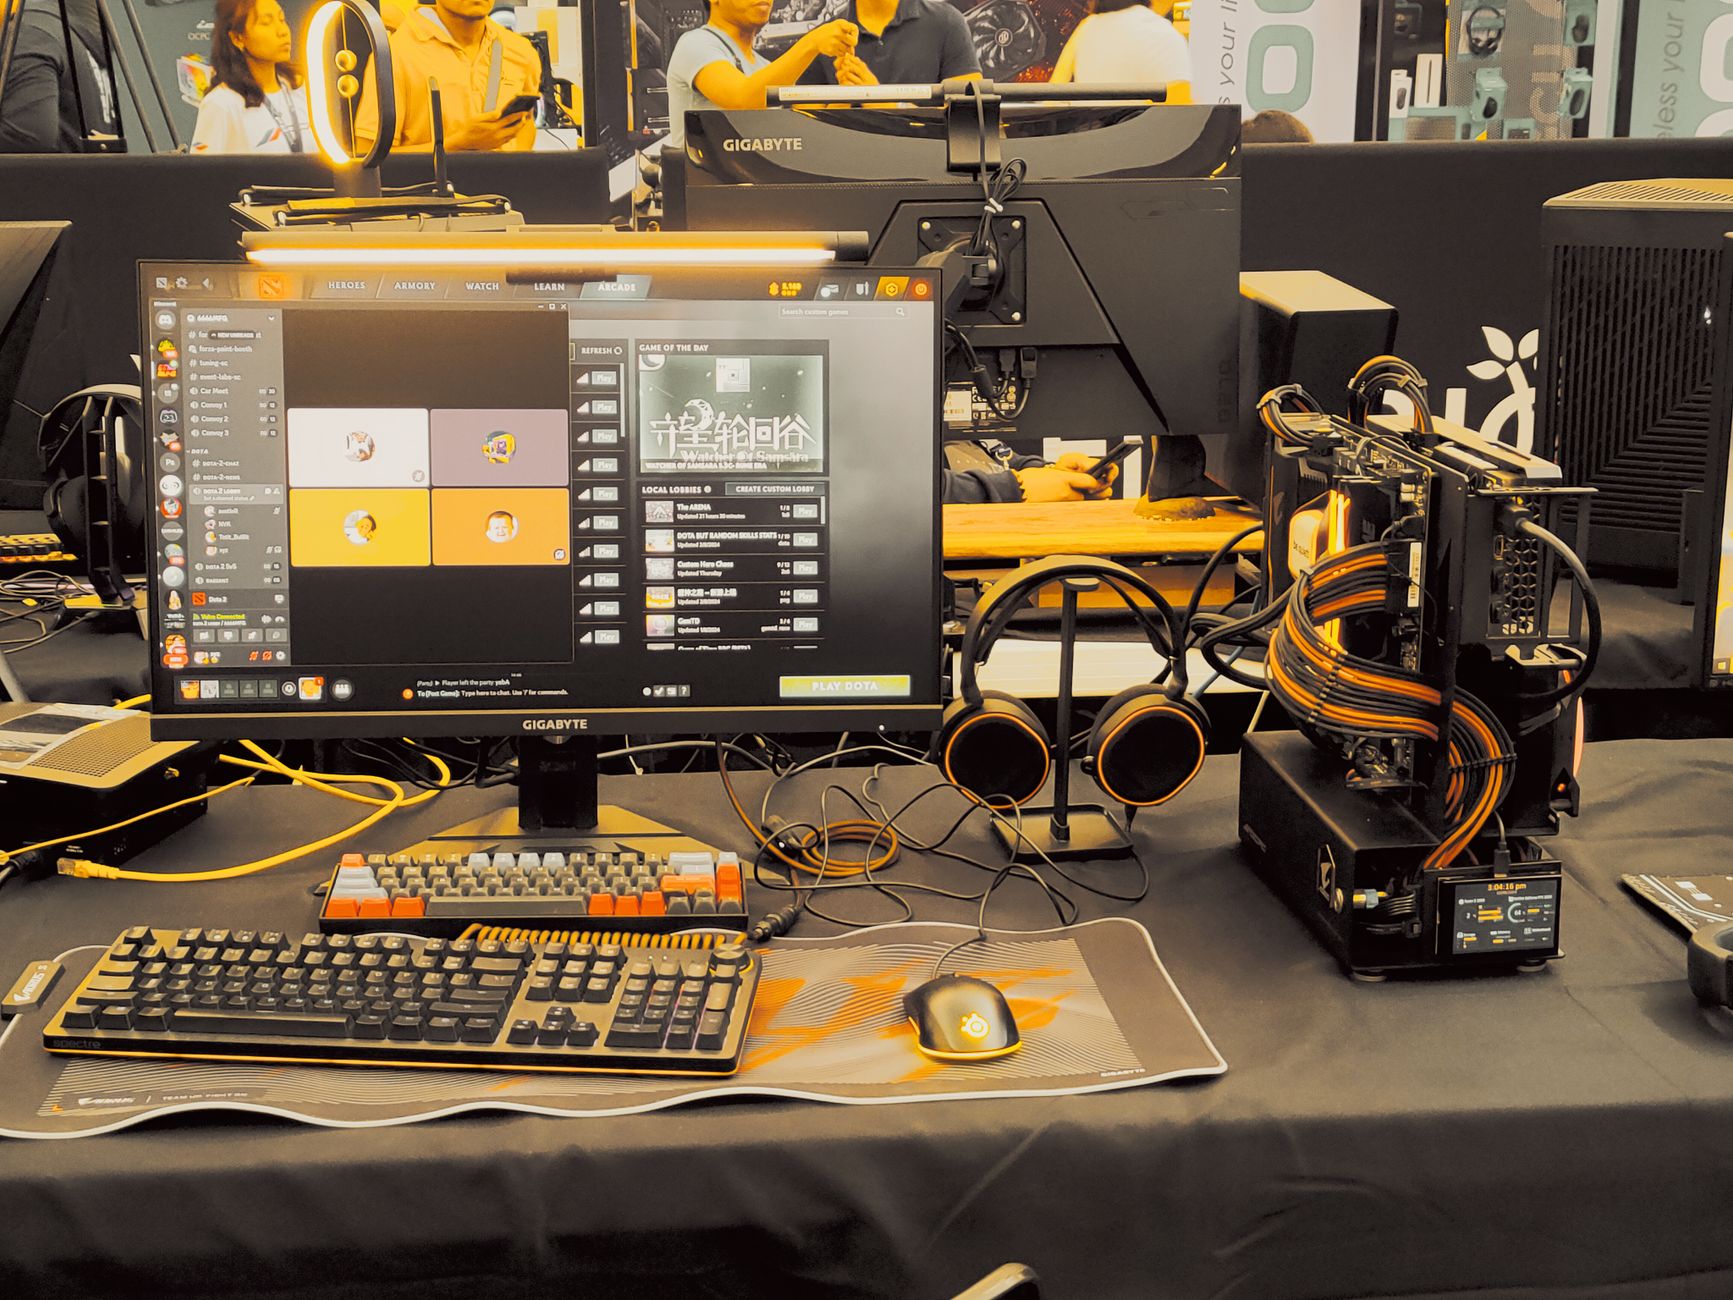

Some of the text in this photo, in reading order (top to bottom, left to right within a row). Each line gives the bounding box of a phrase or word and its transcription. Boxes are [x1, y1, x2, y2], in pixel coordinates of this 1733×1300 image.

[1662, 11, 1686, 72] your
[1220, 21, 1236, 86] your
[723, 136, 803, 152] GIGABYTE
[328, 280, 366, 291] HEROES
[394, 280, 436, 292] ARMORY
[465, 281, 500, 292] WATCH
[534, 282, 566, 292] LEARN
[598, 283, 637, 293] ARCADE
[782, 308, 802, 316] Search
[581, 347, 613, 356] REFRESH
[639, 343, 709, 352] GAME OF THE DAY
[200, 387, 212, 395] Car
[642, 486, 702, 494] LOCAL LOBBIES
[678, 560, 699, 568] Custom
[813, 680, 878, 690] PLAY DOTA
[522, 719, 588, 731] GIGABYTE
[1515, 883, 1527, 891] pm
[53, 1040, 101, 1049] spectre
